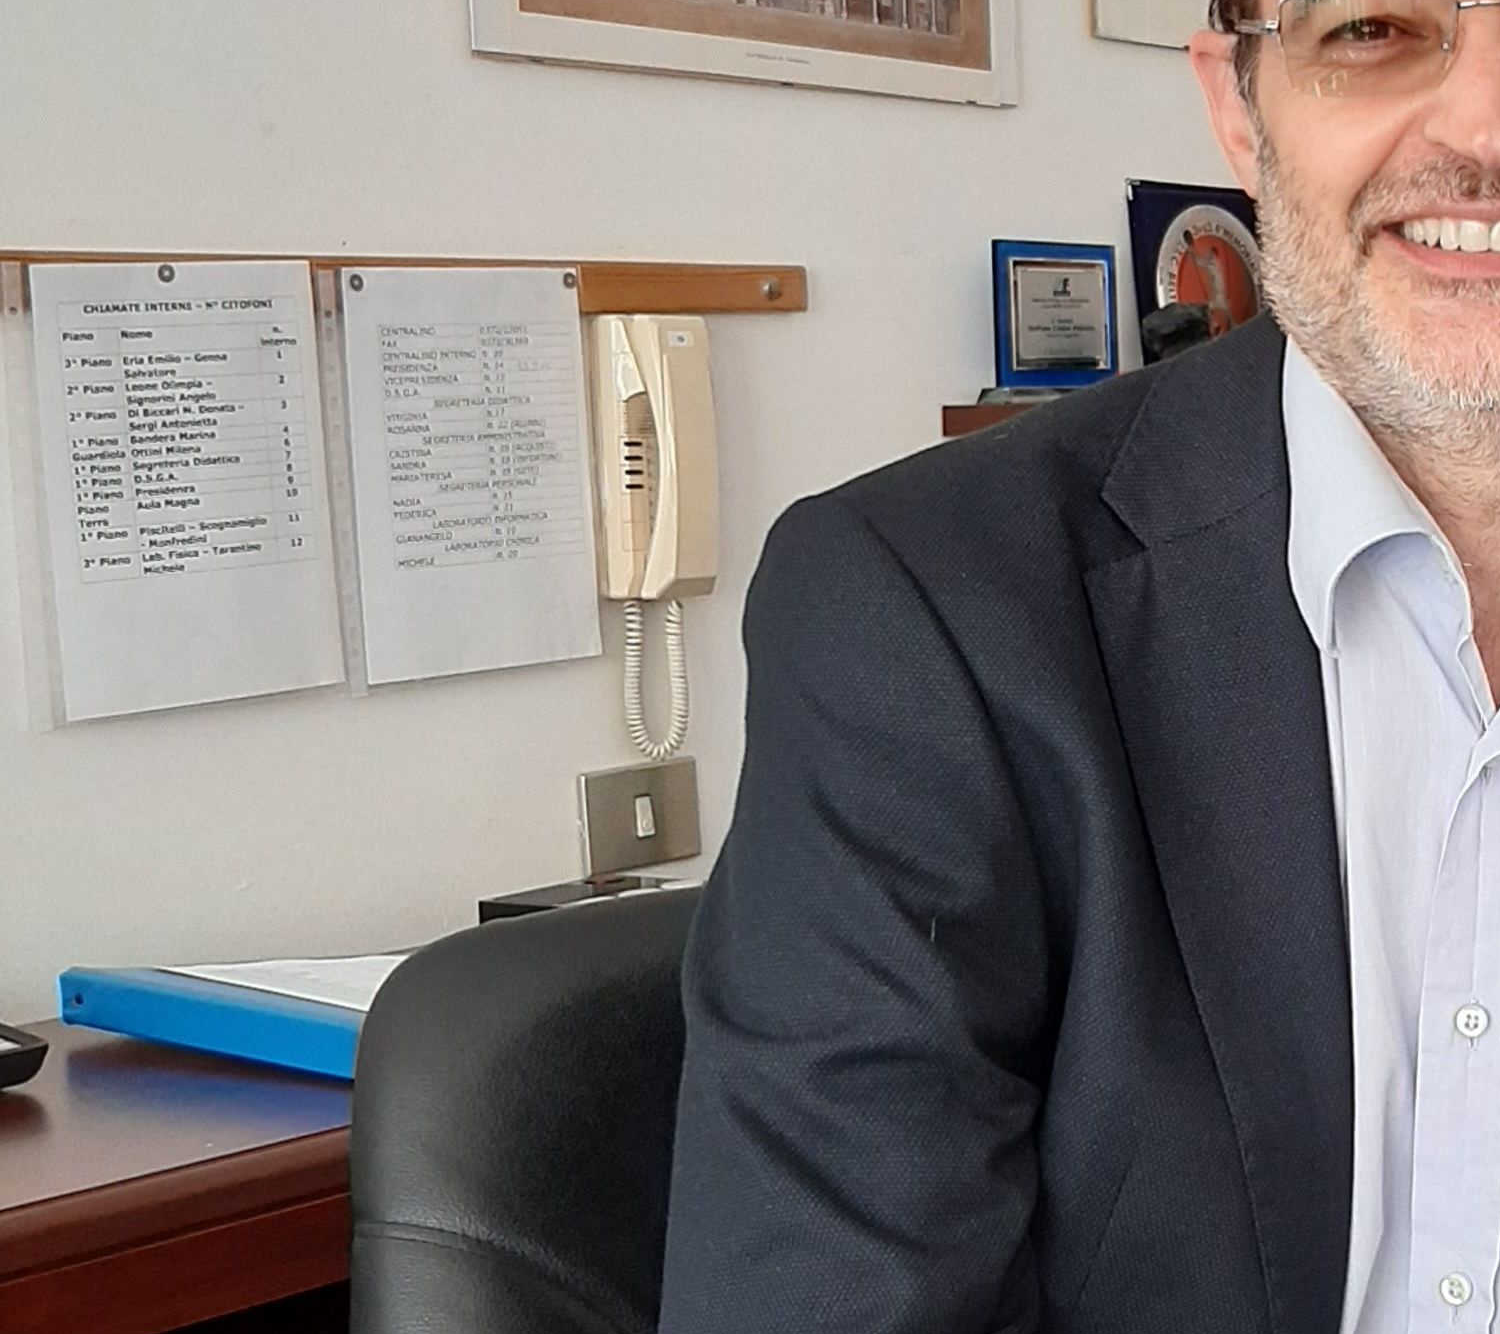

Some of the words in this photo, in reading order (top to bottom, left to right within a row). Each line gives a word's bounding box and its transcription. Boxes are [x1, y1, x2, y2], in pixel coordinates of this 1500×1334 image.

[83, 303, 141, 314] CHIAMATE
[221, 299, 273, 310] CITOFONI
[62, 332, 94, 342] Piano
[120, 330, 153, 339] Nome
[81, 358, 112, 367] Piano
[83, 384, 114, 394] Piano
[85, 411, 117, 420] Piano
[88, 438, 119, 447] Piano
[90, 465, 121, 474] Piano
[92, 478, 122, 487] Piano
[93, 491, 124, 500] Piano
[136, 486, 196, 497] Presidenza
[78, 505, 109, 515] Piano
[97, 530, 128, 540] Piano
